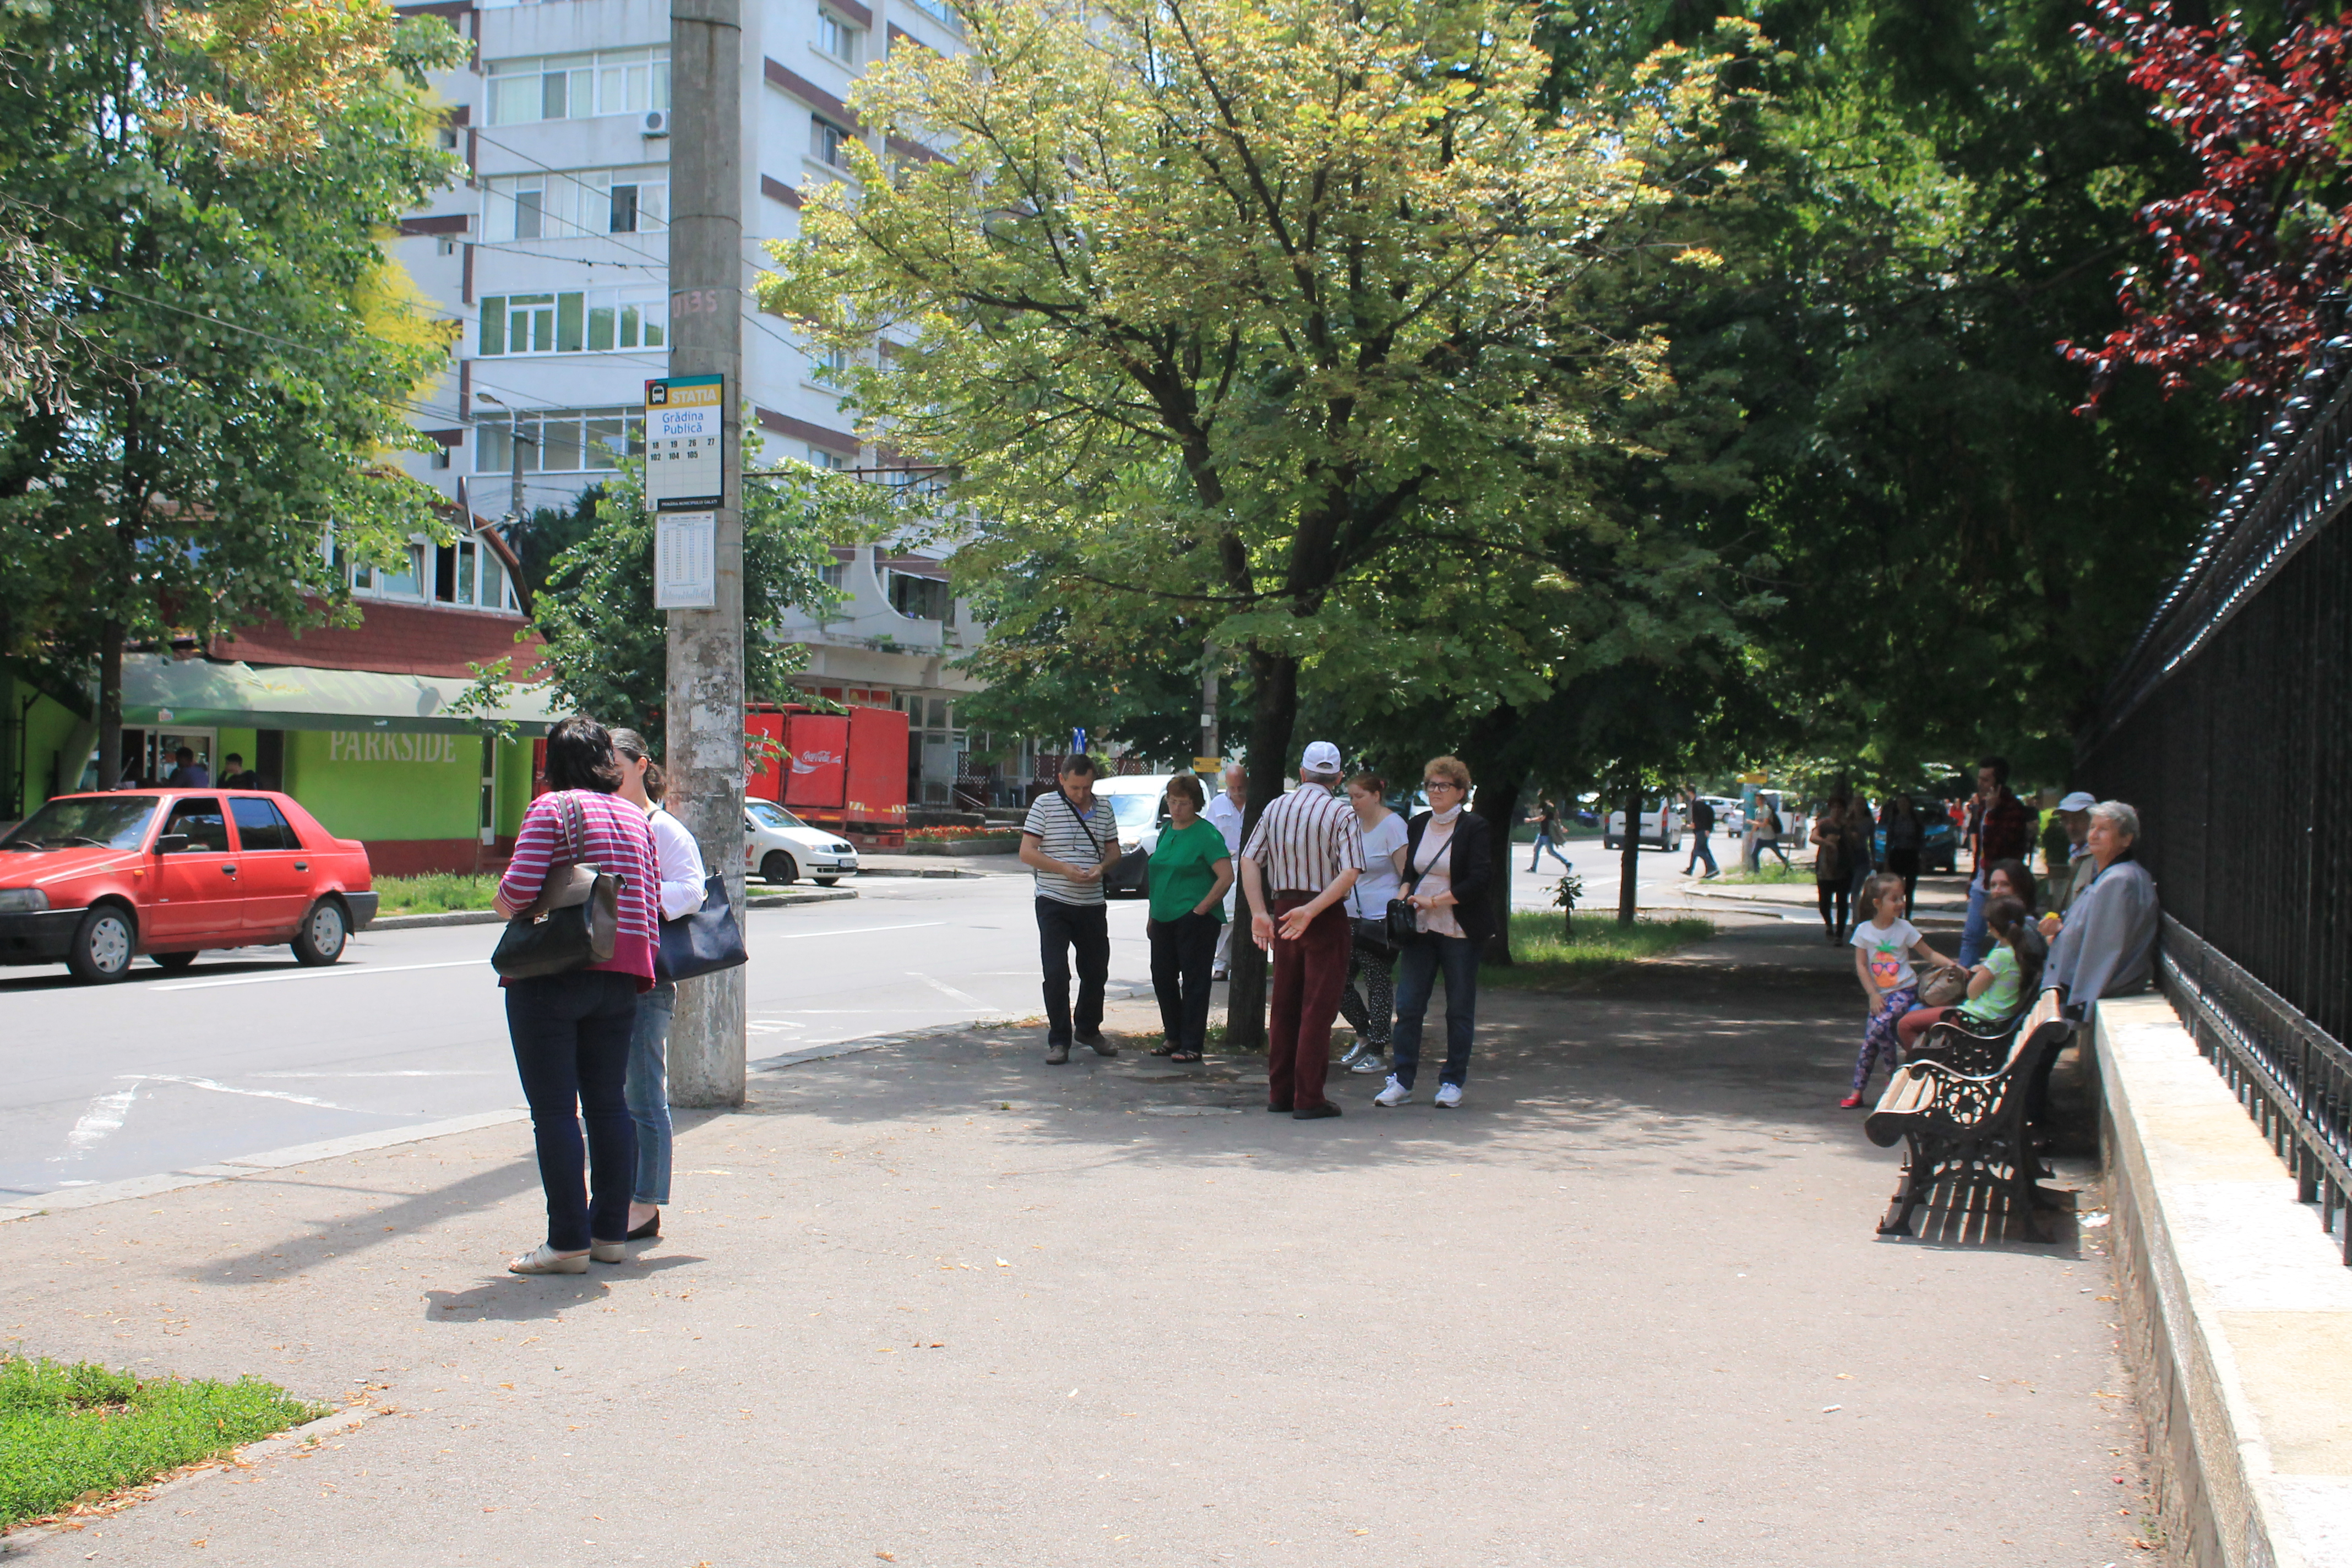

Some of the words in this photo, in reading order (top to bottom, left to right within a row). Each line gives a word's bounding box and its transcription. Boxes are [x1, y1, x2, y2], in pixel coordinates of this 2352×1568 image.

[662, 412, 703, 423] Grădina
[664, 422, 702, 434] Publică
[669, 452, 679, 460] 104
[330, 731, 456, 763] PARKSIDE
